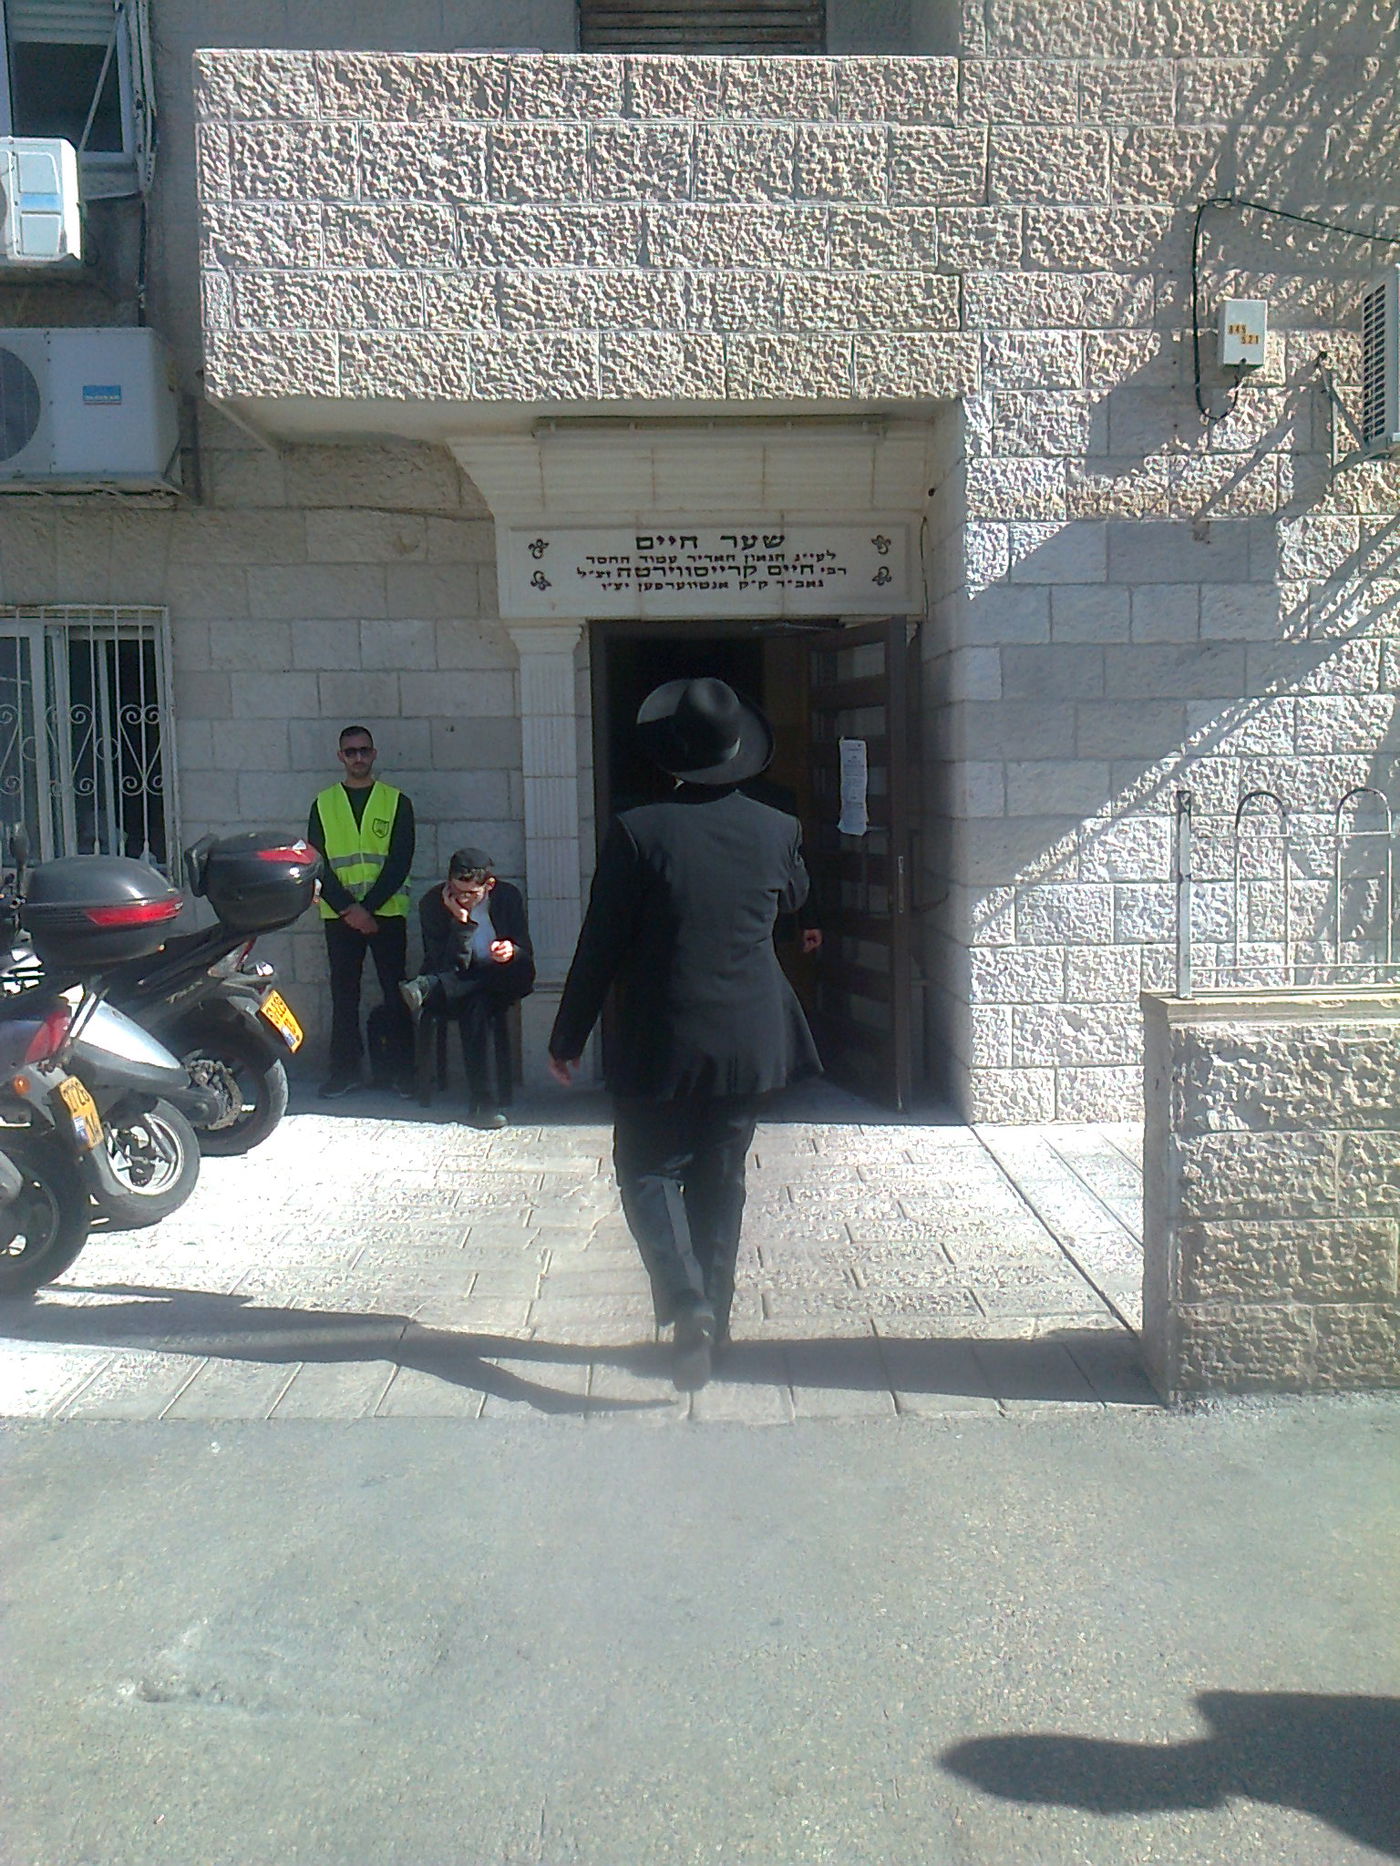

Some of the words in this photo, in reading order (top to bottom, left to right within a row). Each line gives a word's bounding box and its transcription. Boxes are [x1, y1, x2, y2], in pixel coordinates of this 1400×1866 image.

[636, 535, 698, 550] חיים
[720, 535, 785, 551] שער
[639, 555, 677, 564] עמוד
[687, 554, 736, 563] האדיר
[744, 553, 785, 565] הגאון
[767, 564, 814, 576] חיים
[820, 567, 847, 575] רבי
